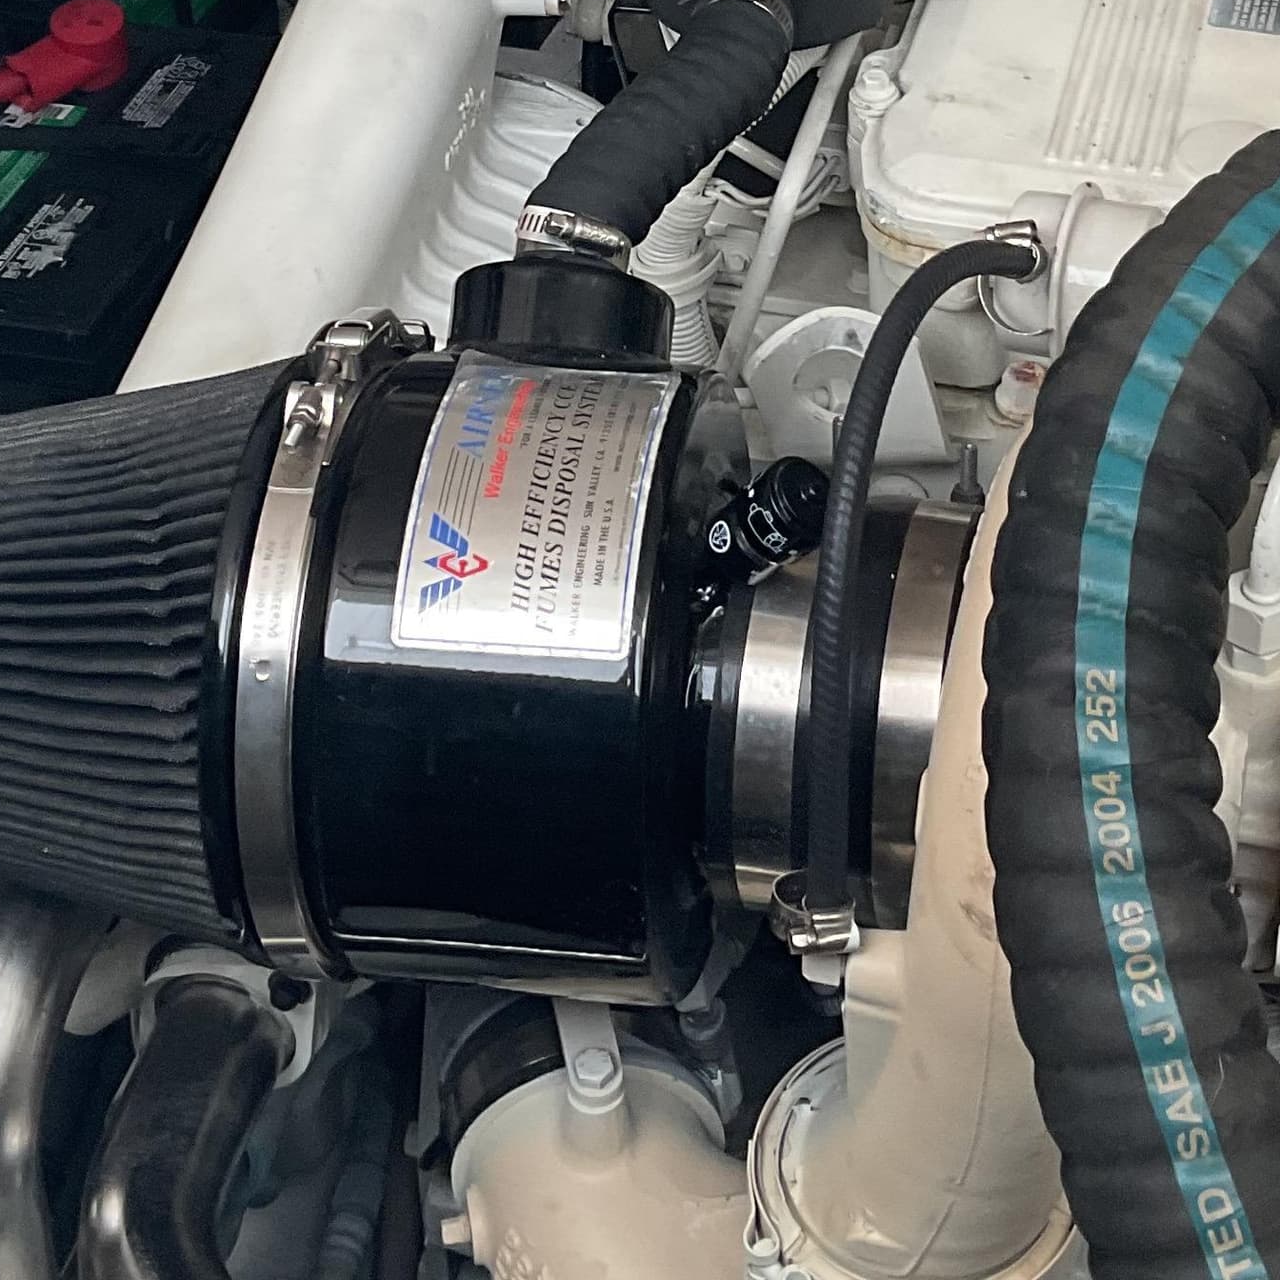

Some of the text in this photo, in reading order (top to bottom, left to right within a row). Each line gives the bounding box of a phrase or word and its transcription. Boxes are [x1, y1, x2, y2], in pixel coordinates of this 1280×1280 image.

[484, 448, 509, 499] Walker
[521, 412, 566, 537] EFFICIENCY
[548, 433, 586, 537] DISPOSAL
[573, 524, 590, 589] ENGINEERING
[598, 545, 608, 556] IN
[599, 525, 611, 542] THE
[511, 543, 537, 613] HIGH
[535, 542, 564, 633] FUMES
[594, 560, 605, 586] MADE
[1085, 668, 1253, 1280] TED SAE J 2006 2004 252
